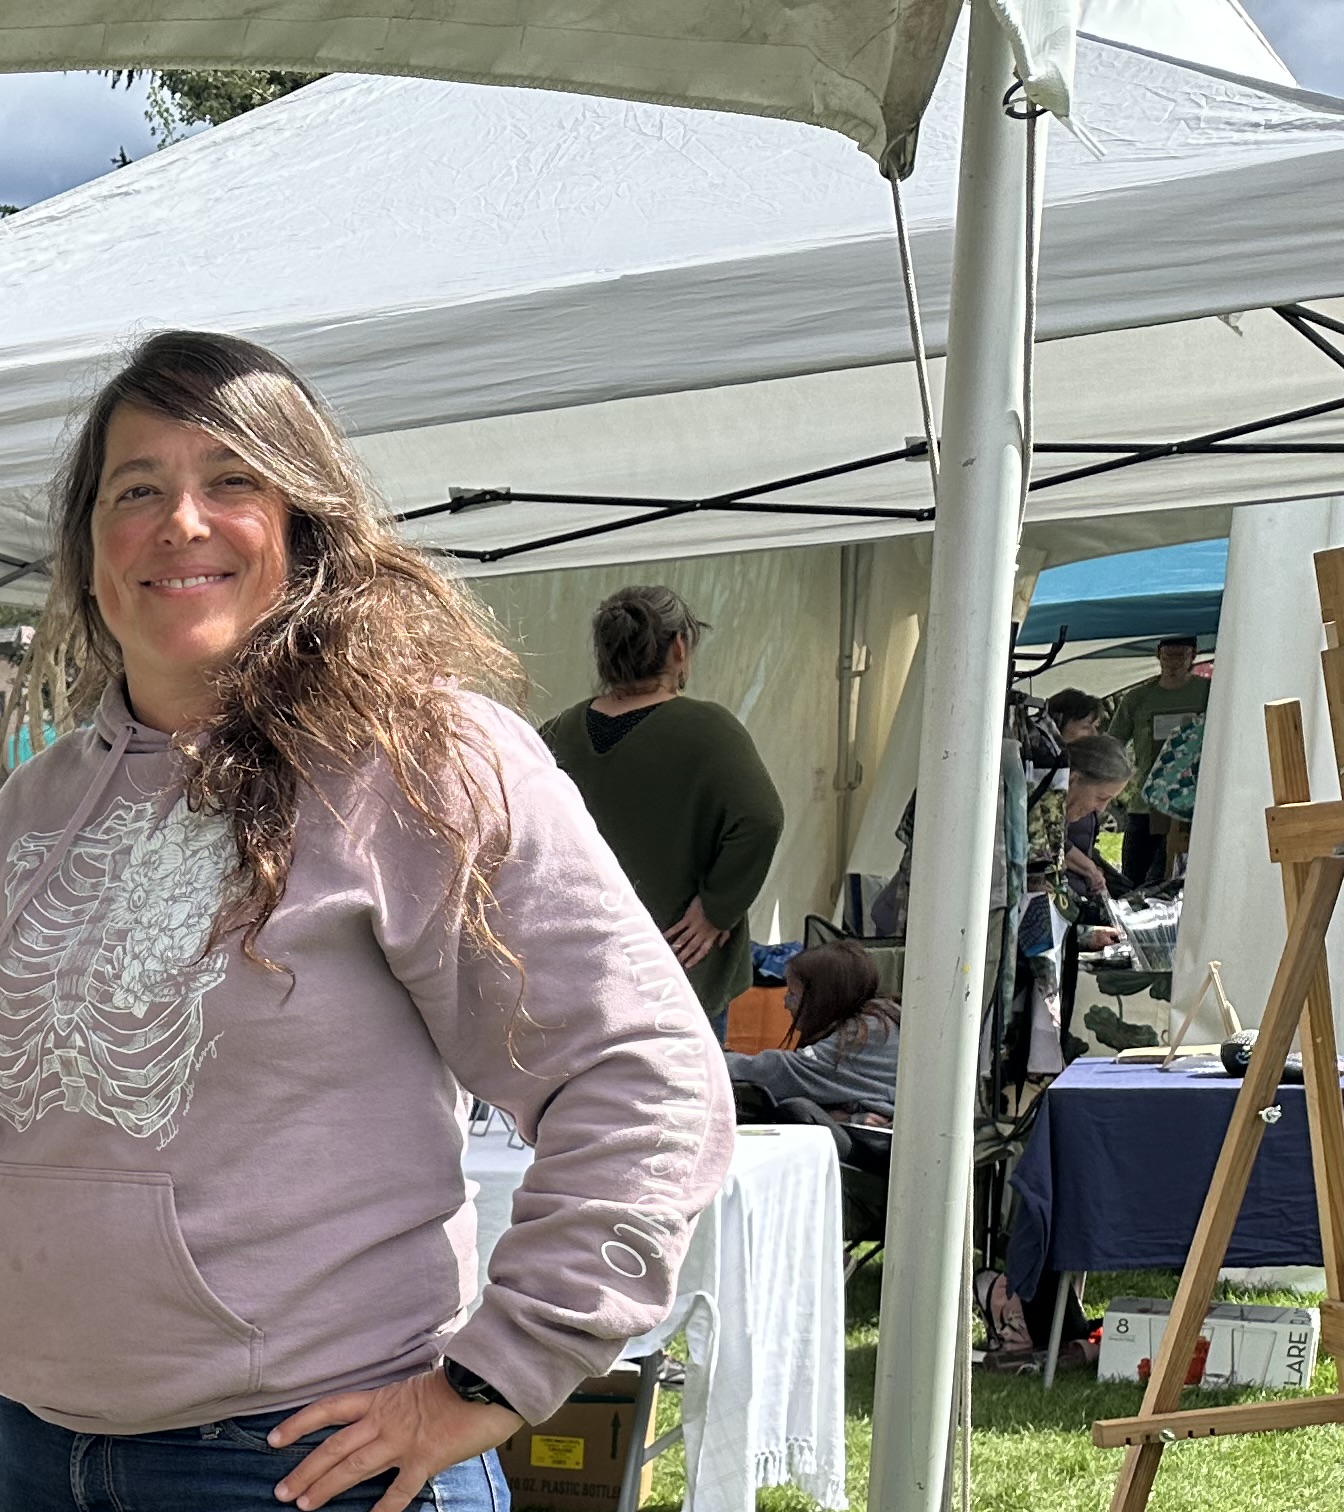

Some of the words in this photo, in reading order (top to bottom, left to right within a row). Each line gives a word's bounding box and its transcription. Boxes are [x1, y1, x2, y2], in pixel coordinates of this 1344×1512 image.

[598, 888, 668, 983] STILL
[191, 1029, 225, 1072] design
[600, 1222, 665, 1280] CO
[1116, 1318, 1130, 1334] 8
[1282, 1331, 1309, 1388] LARE
[522, 1477, 538, 1492] OZ.
[540, 1479, 581, 1496] PLASTIC
